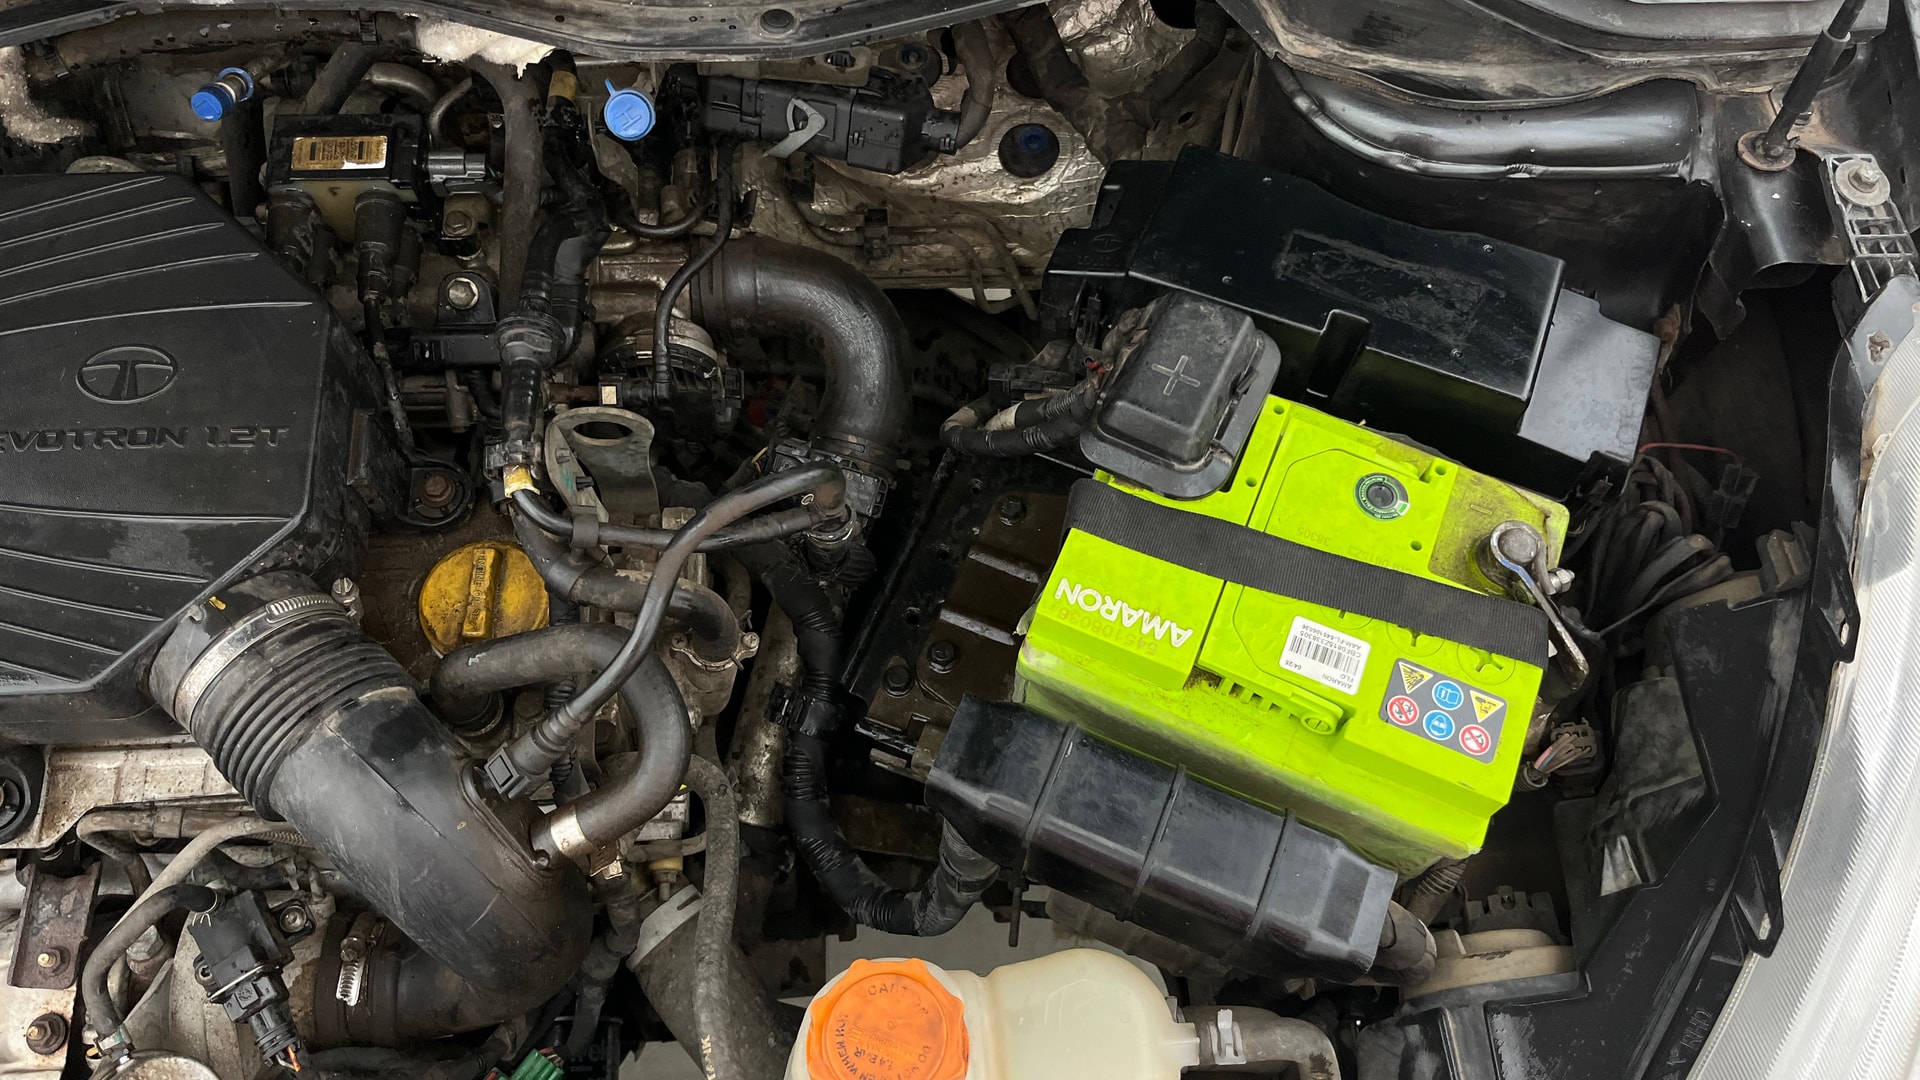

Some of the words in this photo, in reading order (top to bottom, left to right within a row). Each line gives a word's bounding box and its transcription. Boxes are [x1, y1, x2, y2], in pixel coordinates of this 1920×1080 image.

[205, 425, 290, 448] 1.2T
[1054, 577, 1194, 649] AMARON
[1056, 606, 1159, 656] 545106036
[1322, 674, 1352, 689] AMARON
[1340, 673, 1355, 683] FLO
[1679, 1009, 1712, 1050] RHD
[836, 1040, 859, 1076] WHEN
[917, 1044, 932, 1064] DO
